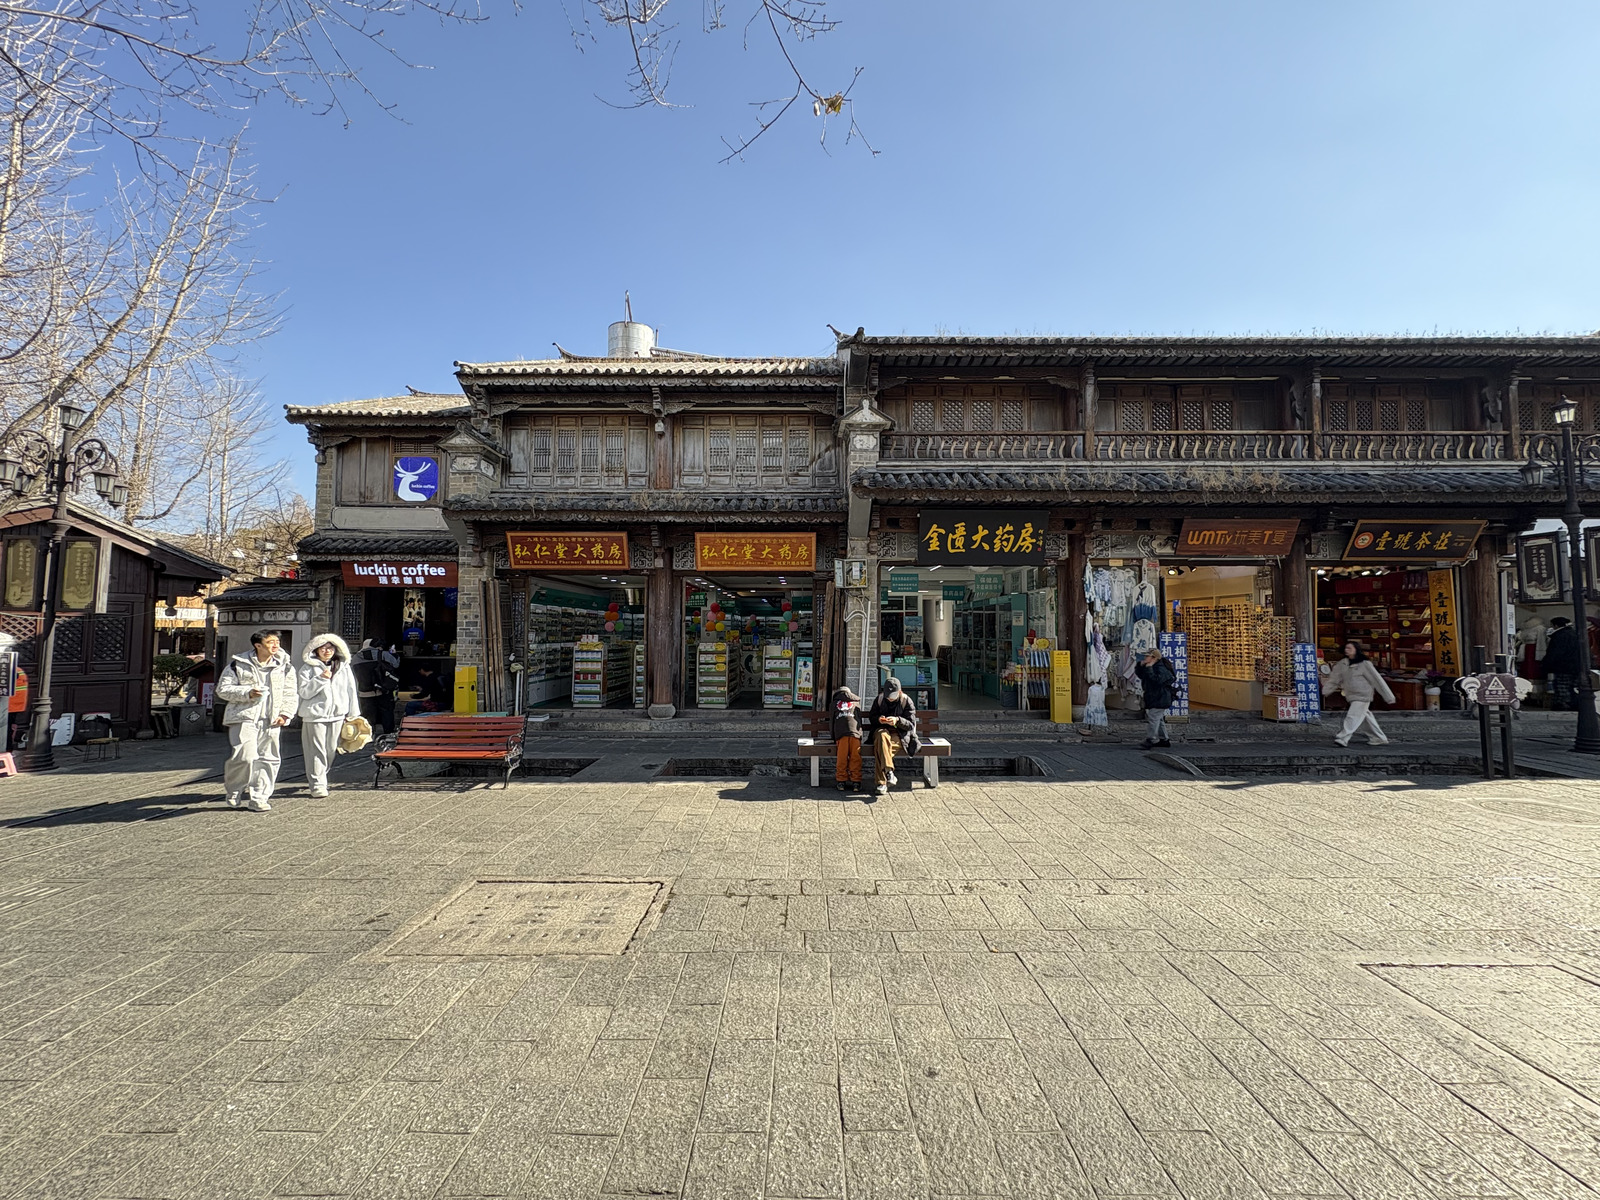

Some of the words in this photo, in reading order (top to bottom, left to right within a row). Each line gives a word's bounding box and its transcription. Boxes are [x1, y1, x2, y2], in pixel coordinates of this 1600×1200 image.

[921, 521, 1037, 553] 金匮大药房
[514, 542, 622, 559] 弘仁堂大药房
[702, 543, 810, 560] 弘仁堂大药房
[353, 563, 397, 576] luckin
[401, 563, 446, 576] coffee
[378, 576, 425, 585] 瑞幸咖啡
[1173, 633, 1188, 683] 手机配件
[1294, 644, 1306, 681] 手机贴膜
[1304, 644, 1317, 681] 手机配件
[1279, 698, 1298, 708] 刻章
[1307, 683, 1319, 710] 充电器
